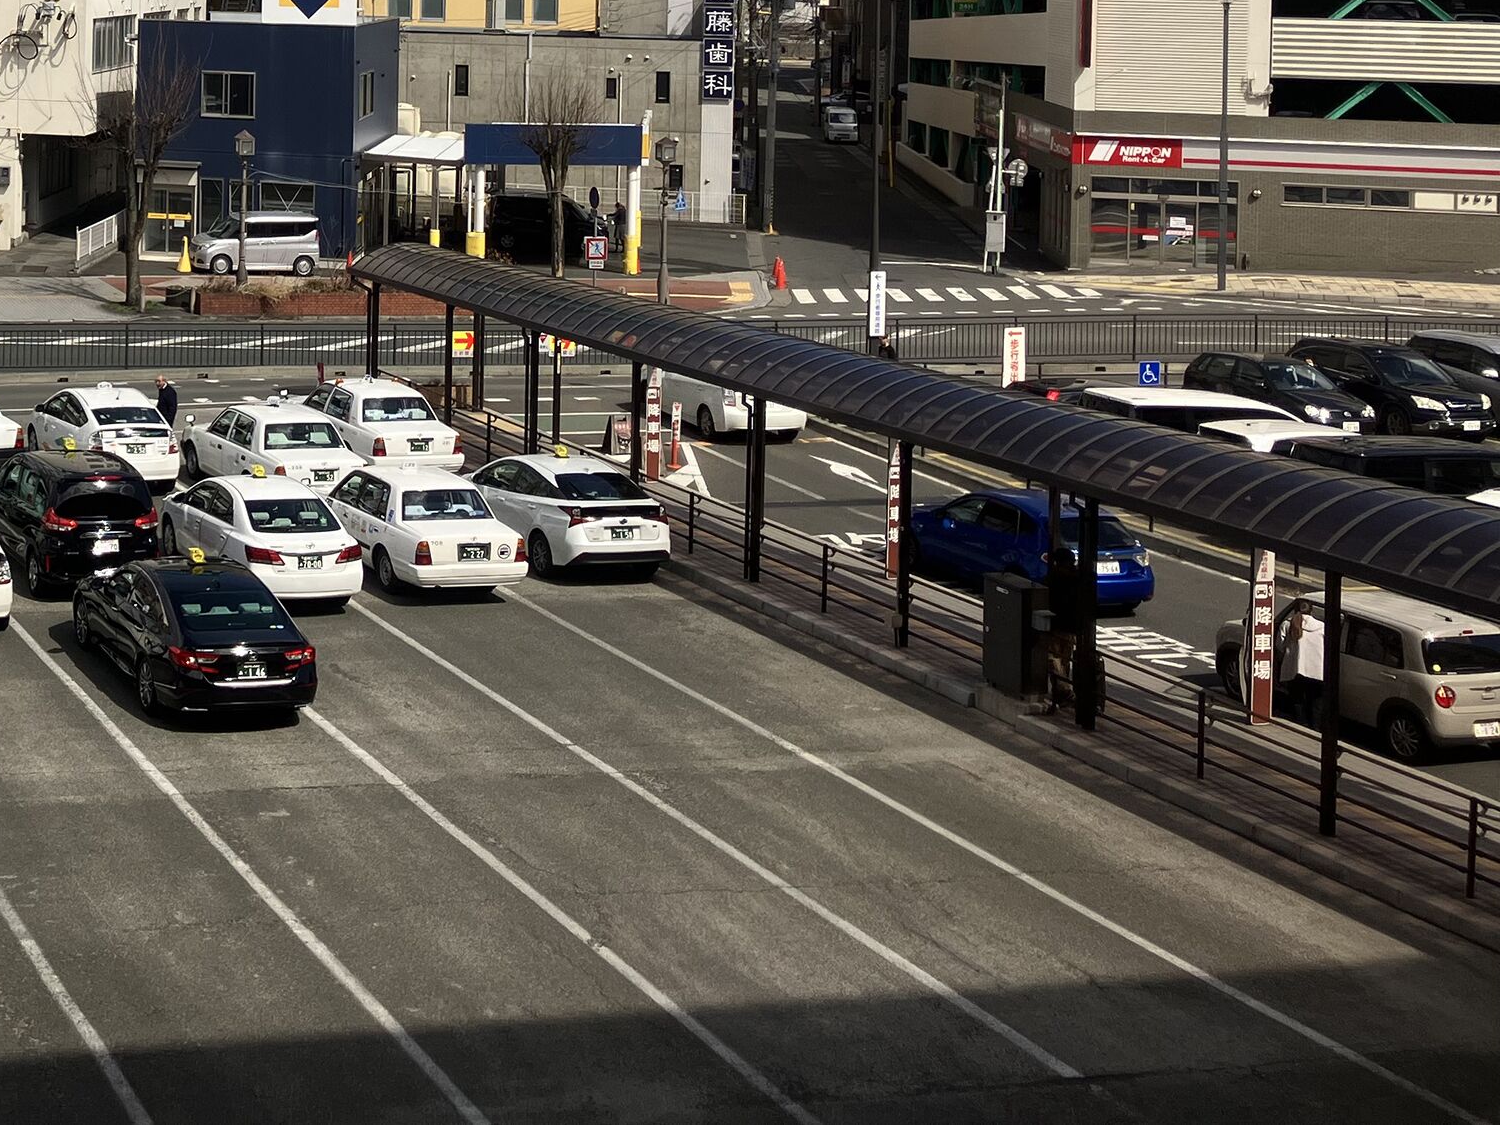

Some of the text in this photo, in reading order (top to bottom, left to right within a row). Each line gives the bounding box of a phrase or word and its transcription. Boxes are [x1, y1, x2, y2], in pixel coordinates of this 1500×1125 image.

[1119, 145, 1171, 158] NIPPON
[1253, 606, 1272, 680] 降車場
